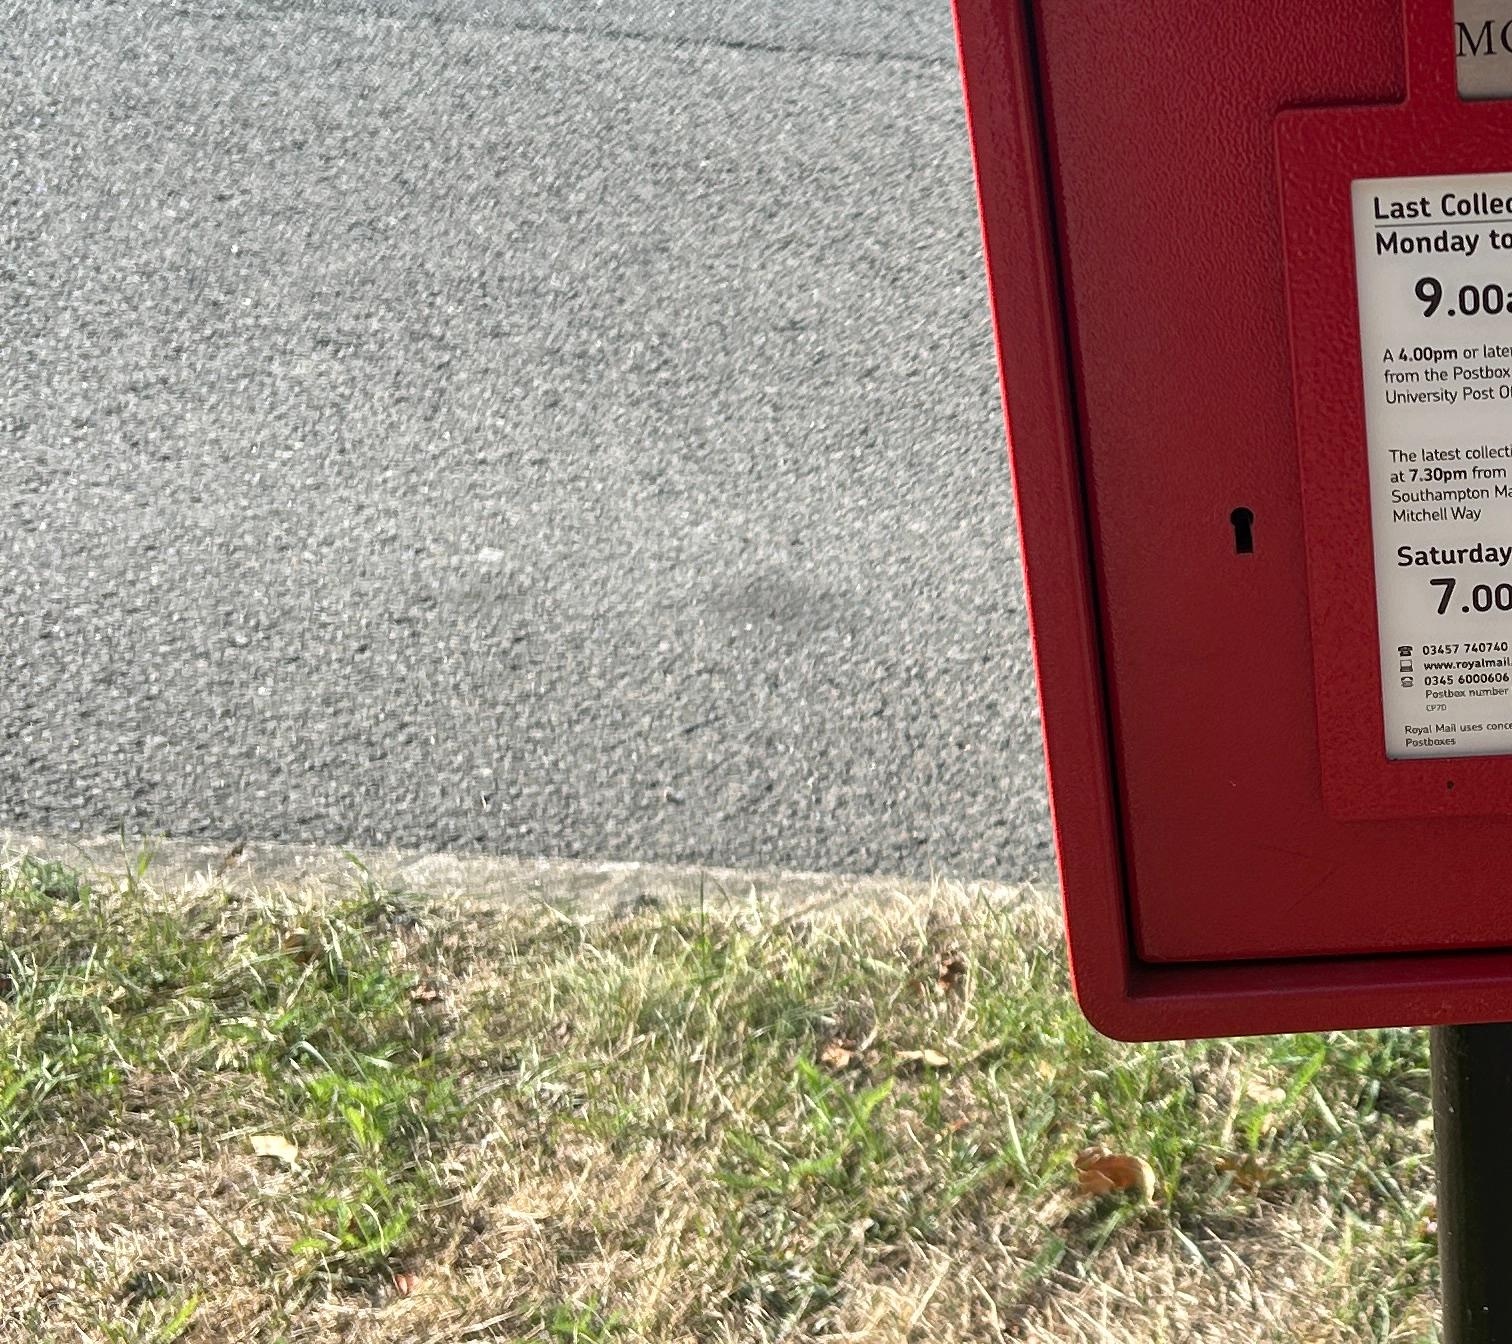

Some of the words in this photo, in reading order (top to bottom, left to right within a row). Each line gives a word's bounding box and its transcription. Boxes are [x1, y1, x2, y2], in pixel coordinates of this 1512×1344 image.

[1374, 196, 1431, 220] Last
[1375, 230, 1479, 256] Monday
[1383, 349, 1394, 362] A
[1398, 347, 1458, 364] 4.00pm
[1463, 346, 1479, 359] or
[1384, 370, 1419, 383] from
[1425, 368, 1448, 381] the
[1454, 366, 1511, 380] Postbox
[1386, 388, 1458, 405] University
[1463, 386, 1495, 400] Post
[1389, 449, 1417, 464] The
[1421, 447, 1461, 462] latest
[1390, 470, 1405, 483] at
[1409, 468, 1468, 483] 7.30pm
[1472, 466, 1507, 479] from
[1391, 487, 1490, 504] Southampton
[1392, 507, 1447, 523] Mitchell
[1451, 506, 1482, 522] Way
[1397, 543, 1512, 567] Saturday
[1422, 643, 1459, 656] 03457
[1464, 641, 1508, 654] 740740
[1424, 674, 1454, 686] 0345
[1458, 673, 1510, 685] 6000606
[1425, 688, 1466, 699] Postbox
[1469, 686, 1509, 698] number
[1405, 724, 1432, 735] Royal
[1435, 723, 1457, 733] Mail
[1460, 722, 1483, 732] uses
[1405, 736, 1456, 747] Postboxes
